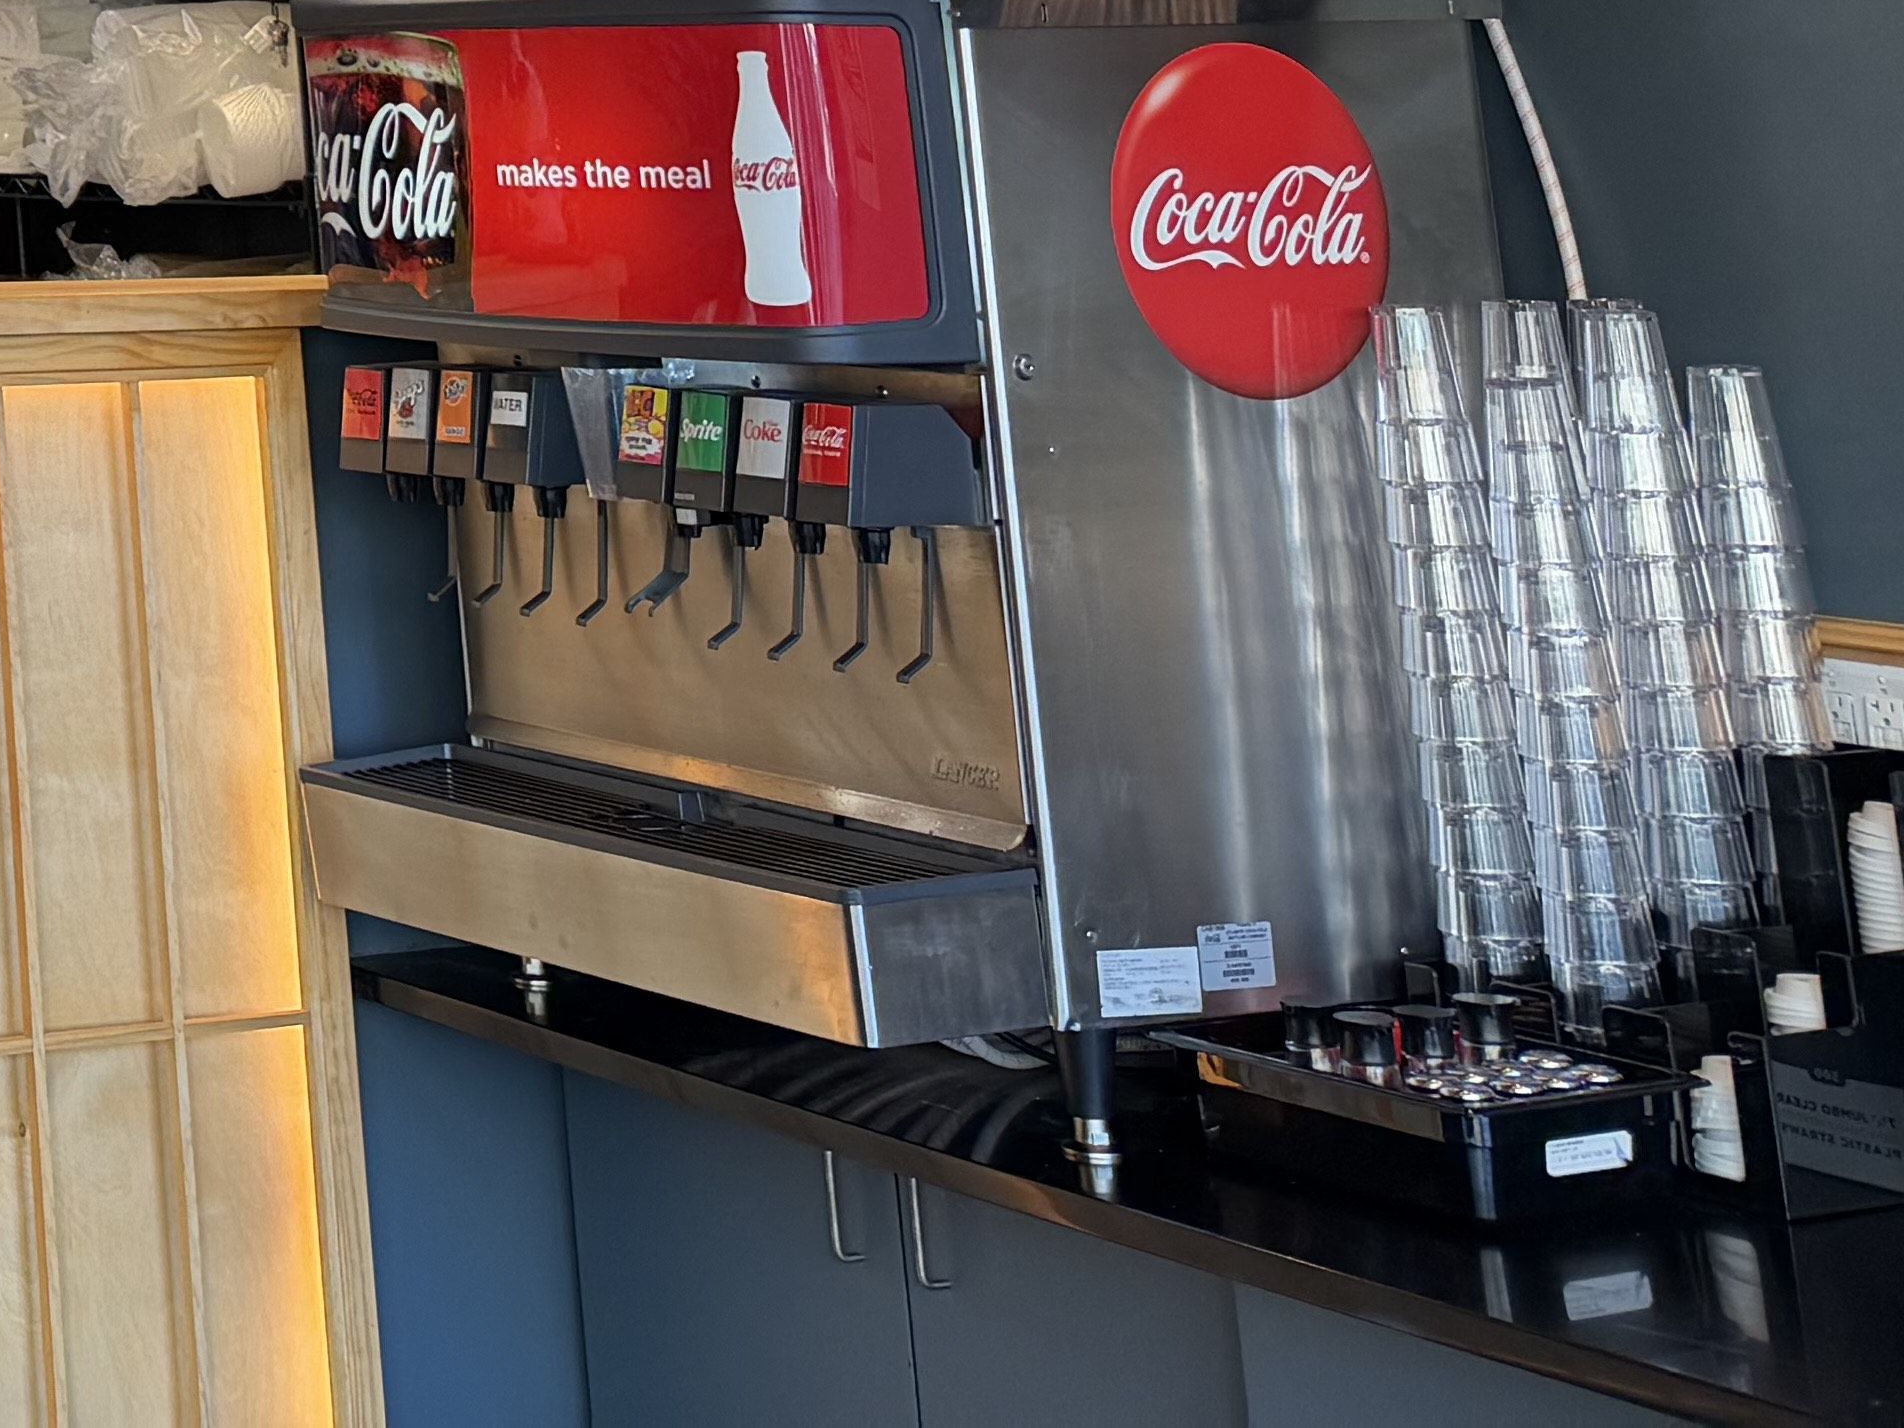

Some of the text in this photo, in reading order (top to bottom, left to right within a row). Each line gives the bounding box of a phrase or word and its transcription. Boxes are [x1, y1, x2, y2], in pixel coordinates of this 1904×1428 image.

[318, 102, 458, 241] ca-Cola
[497, 159, 711, 190] makes the meal
[1131, 163, 1373, 270] Coca-Cola
[680, 419, 723, 441] Sprite
[744, 420, 782, 442] Coke
[803, 425, 847, 448] Coca-Cola
